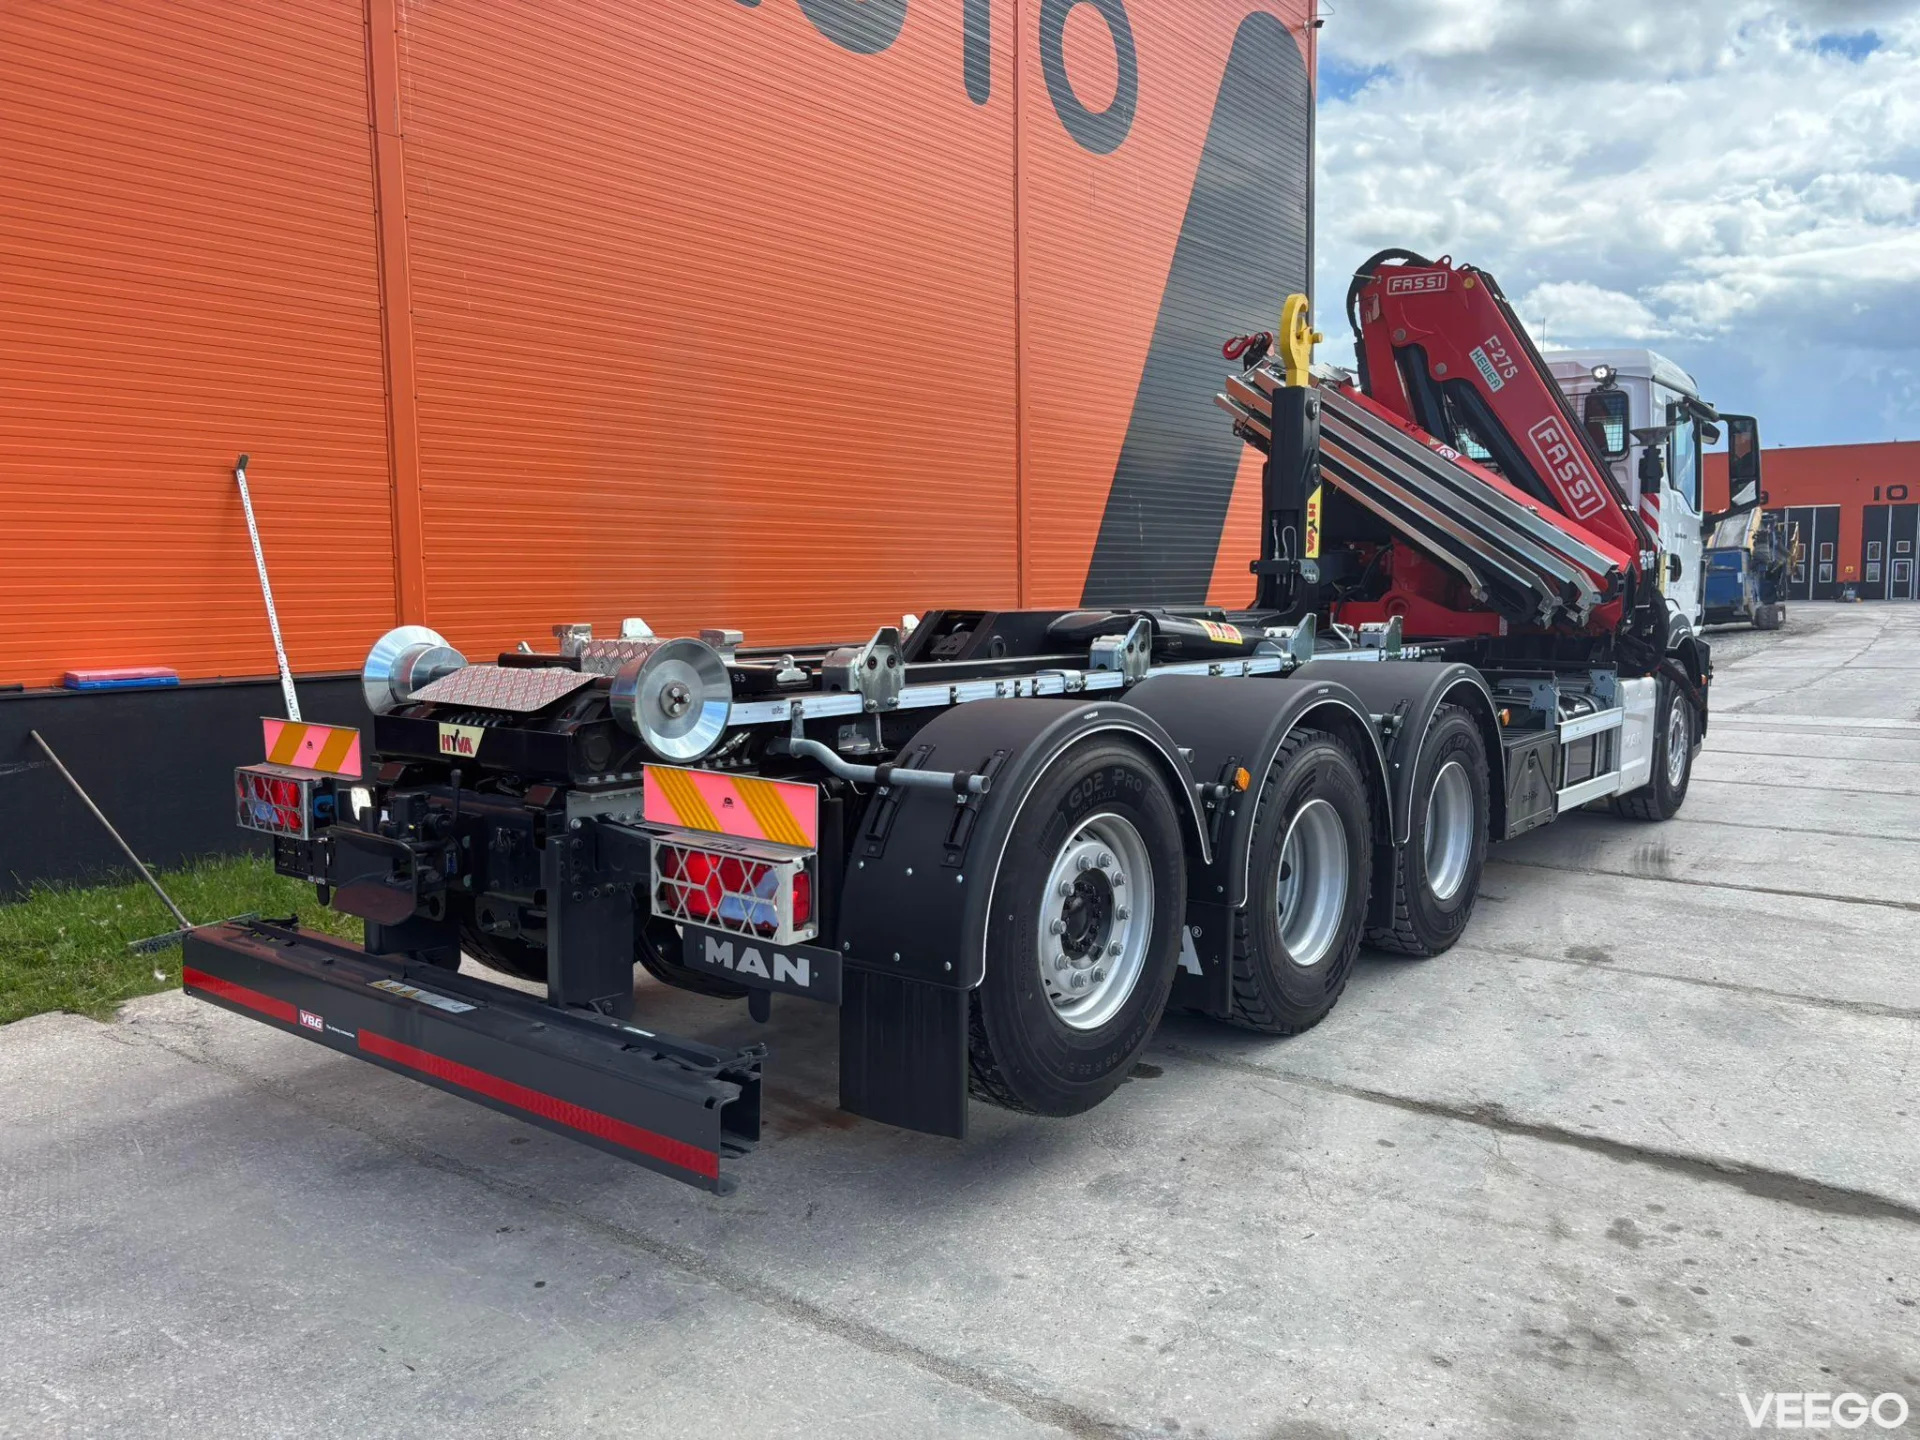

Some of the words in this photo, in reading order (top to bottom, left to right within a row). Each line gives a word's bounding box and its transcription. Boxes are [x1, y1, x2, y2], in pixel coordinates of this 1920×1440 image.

[1391, 275, 1442, 291] FASSI
[1472, 348, 1501, 390] HEWEA
[1484, 335, 1518, 379] F275
[1537, 427, 1596, 509] FASSI
[441, 728, 473, 755] HYVA
[705, 935, 810, 987] MAN
[301, 1012, 322, 1029] VBG
